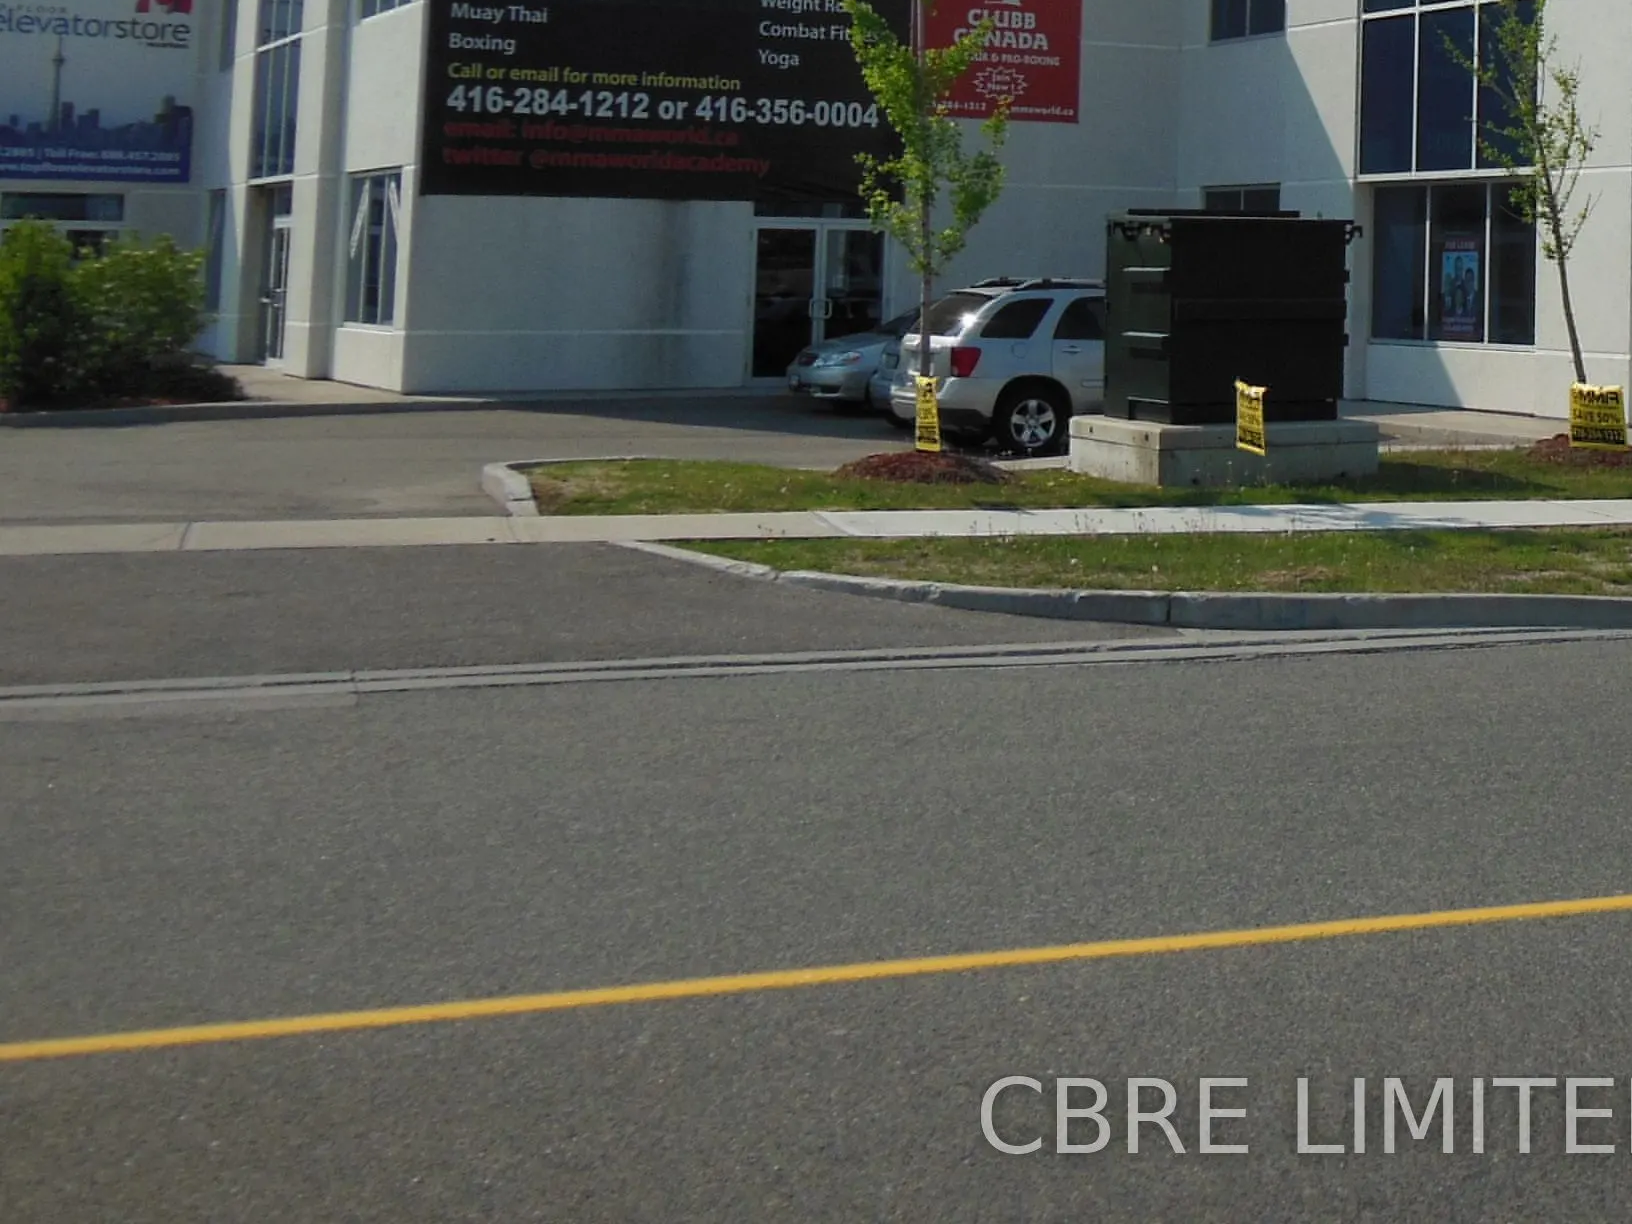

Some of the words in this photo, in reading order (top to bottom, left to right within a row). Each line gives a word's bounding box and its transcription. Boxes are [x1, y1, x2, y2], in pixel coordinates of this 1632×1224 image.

[451, 3, 504, 24] Muay
[507, 5, 548, 23] Thai
[967, 9, 1036, 29] CLUBB
[759, 21, 825, 40] Combat
[954, 28, 1049, 50] CNADA
[449, 33, 516, 55] Boxing
[758, 48, 800, 69] Yoga
[448, 62, 482, 78] Call
[486, 68, 506, 80] or
[509, 67, 559, 83] email
[563, 68, 588, 84] for
[592, 73, 638, 86] more
[642, 71, 741, 91] information
[447, 84, 649, 119] 416-284-1212
[658, 99, 688, 120] or
[695, 95, 879, 128] 416-356-0004
